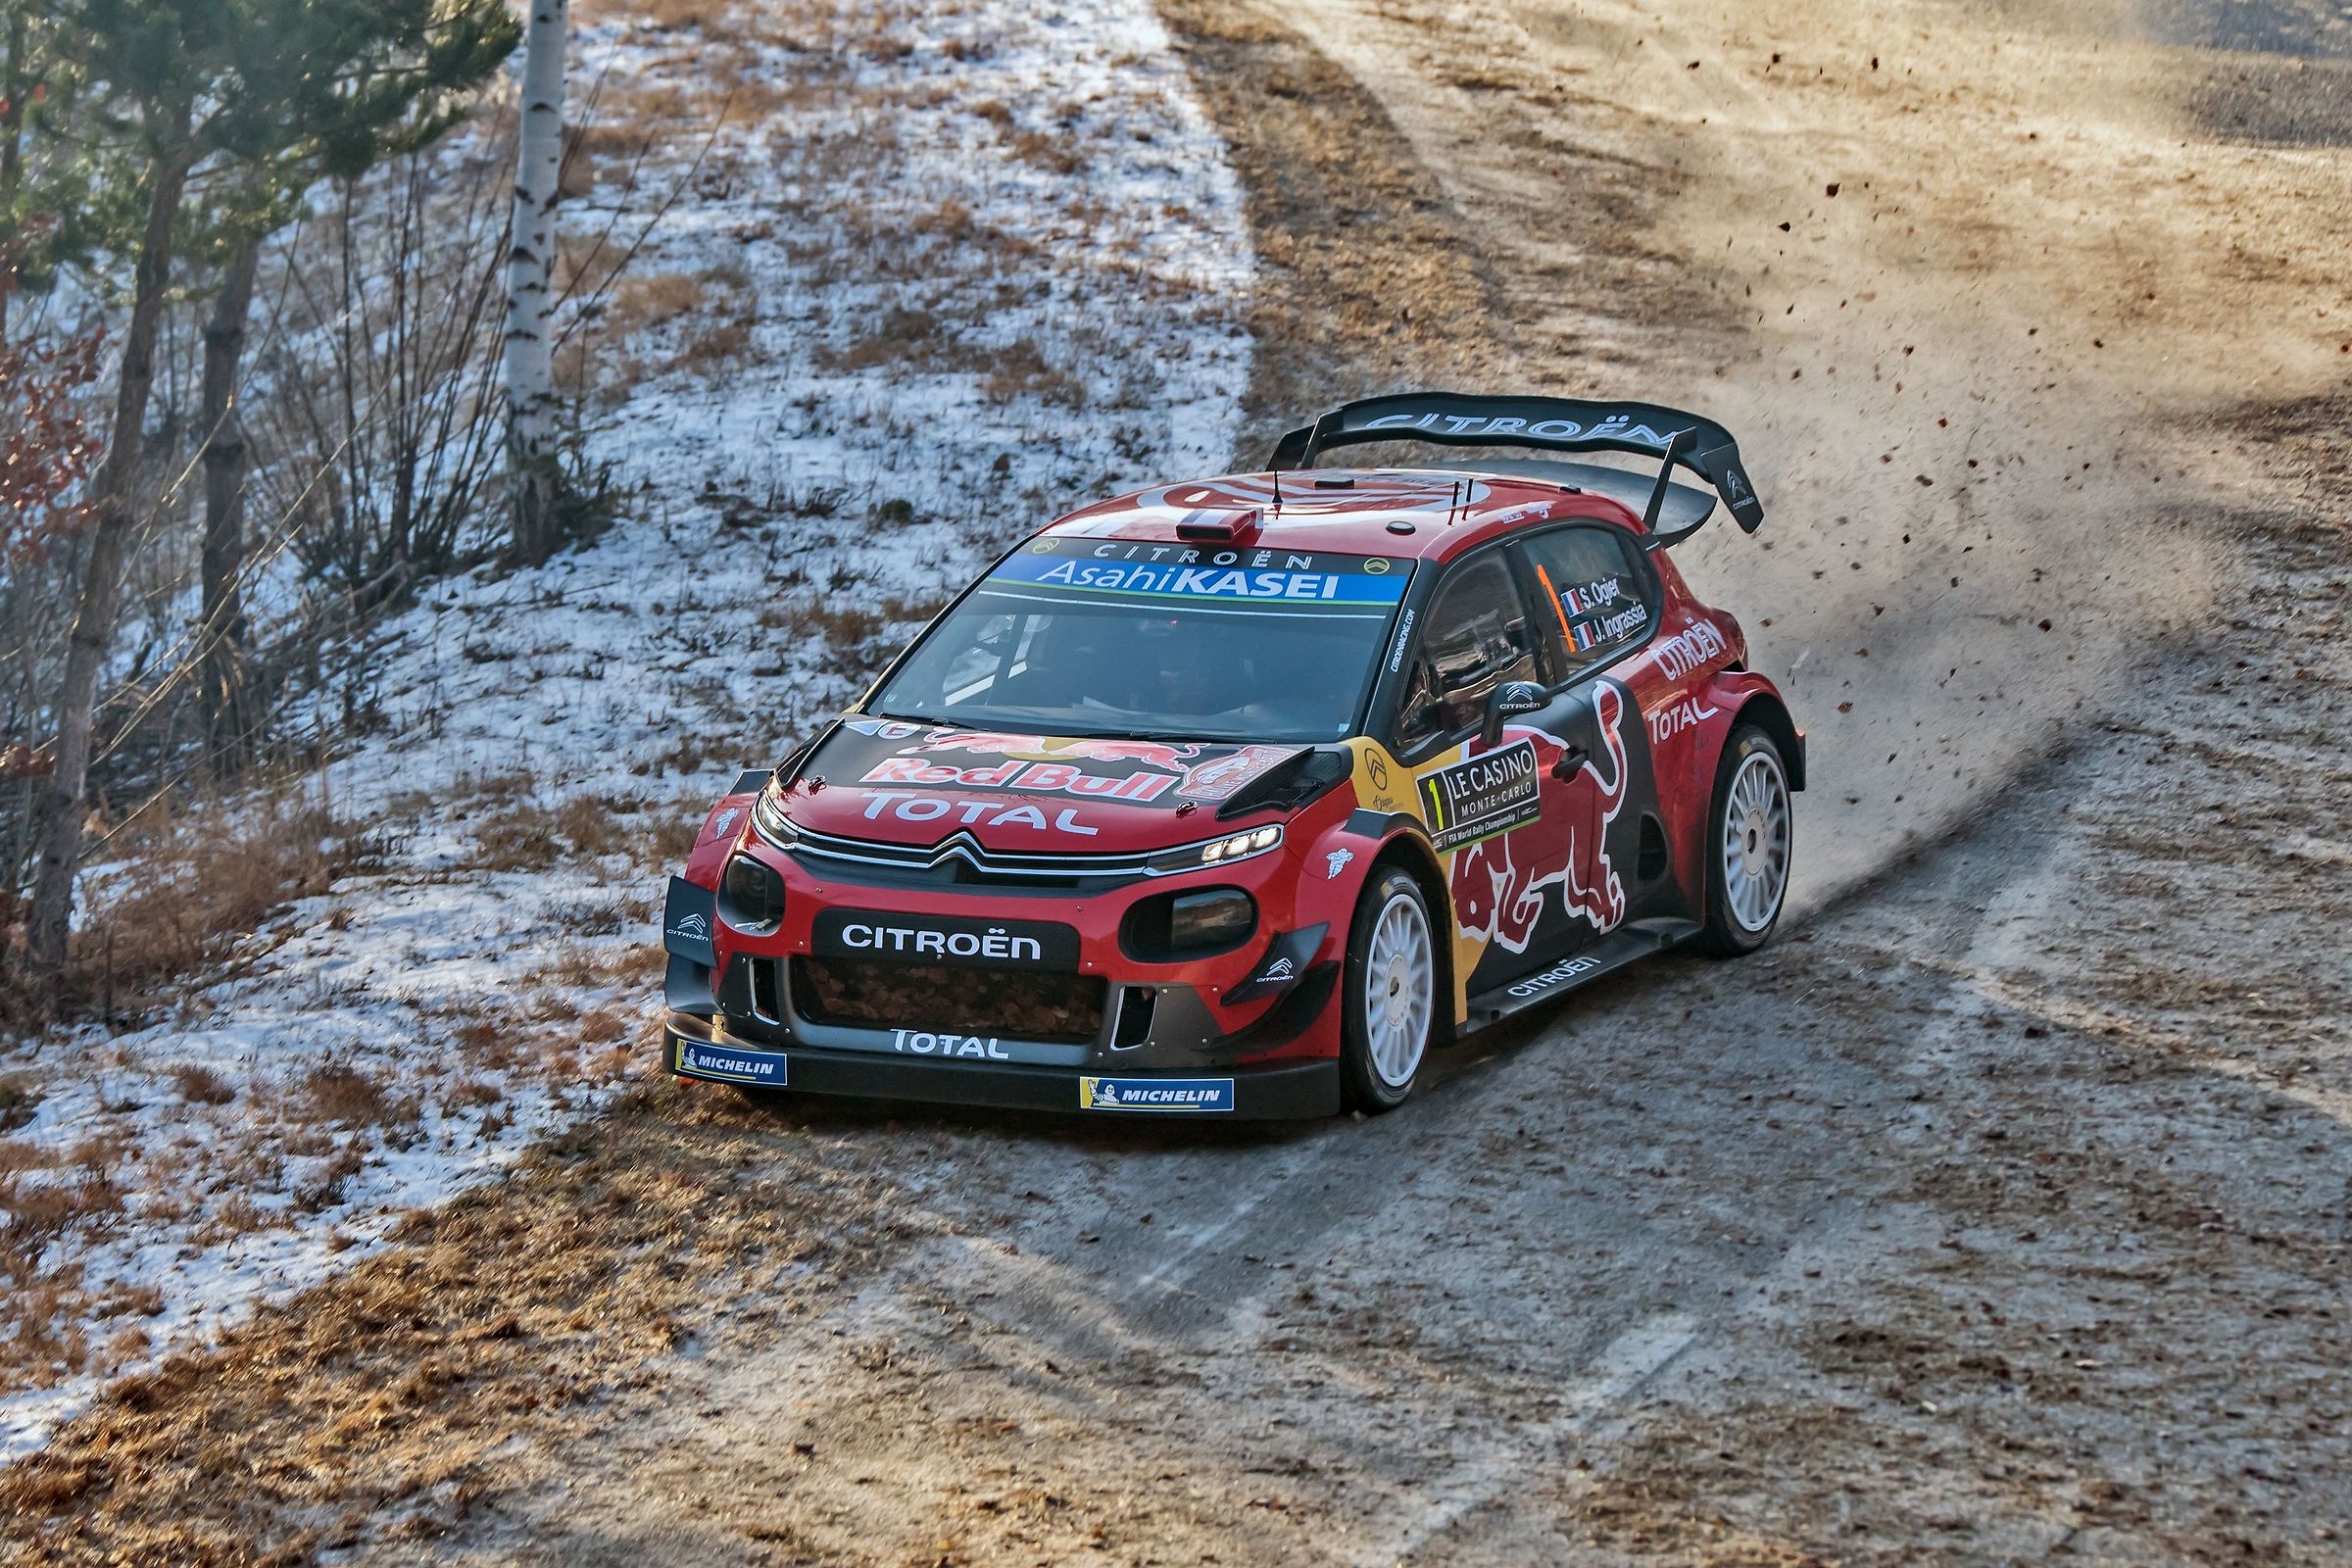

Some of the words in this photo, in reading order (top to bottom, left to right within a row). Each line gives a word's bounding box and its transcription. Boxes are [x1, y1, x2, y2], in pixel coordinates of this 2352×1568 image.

[1093, 544, 1313, 570] CITROËN
[1579, 587, 1595, 610] S.
[1591, 577, 1620, 606] Ogier
[1593, 618, 1606, 642] J.
[1601, 600, 1648, 638] Ingrassia
[1650, 616, 1727, 681] CITROËN
[1647, 697, 1719, 745] TOTAL
[1428, 778, 1444, 831] 1
[1447, 772, 1471, 800] LE
[1470, 749, 1534, 792] CASINO
[860, 792, 1099, 836] TOTAL
[1448, 834, 1457, 844] FIA
[1457, 827, 1472, 841] World
[1472, 824, 1485, 835] Rally
[1485, 812, 1516, 830] Championship
[890, 1028, 1009, 1059] TOTAL
[698, 1054, 774, 1075] MICHELIN
[1121, 1090, 1221, 1102] MICHELIN
